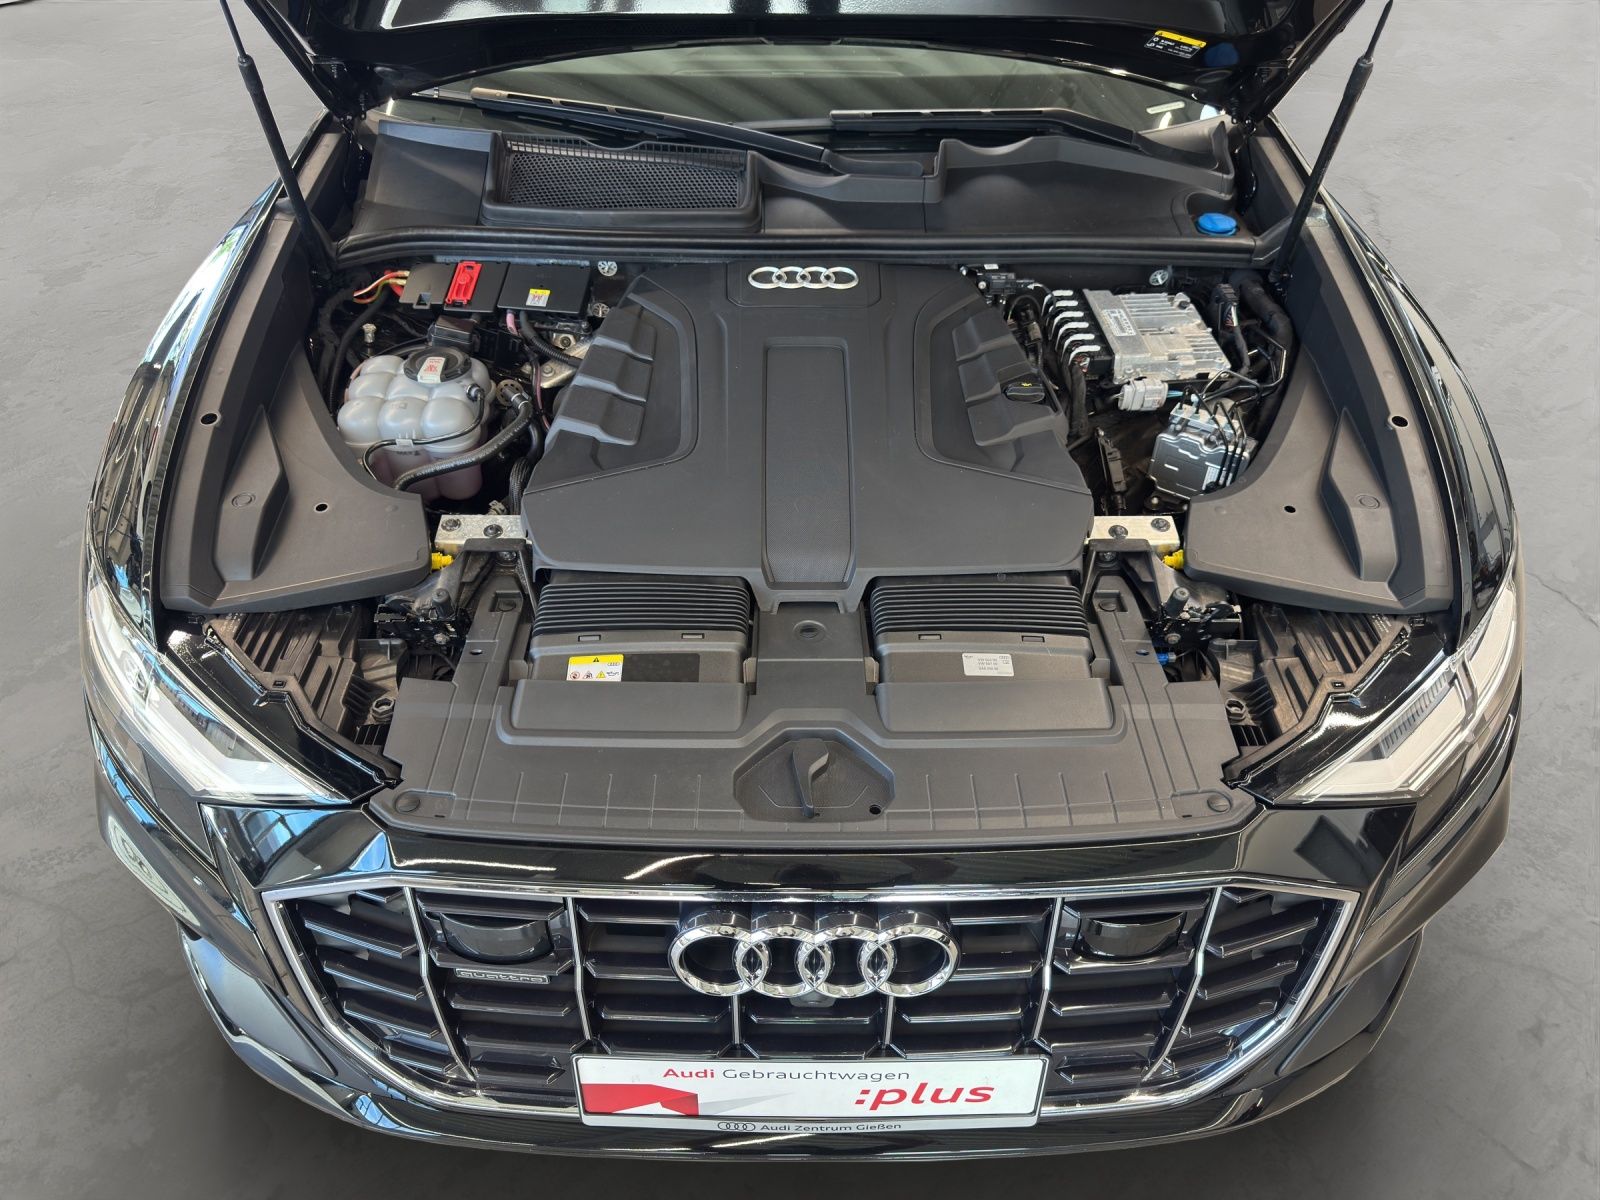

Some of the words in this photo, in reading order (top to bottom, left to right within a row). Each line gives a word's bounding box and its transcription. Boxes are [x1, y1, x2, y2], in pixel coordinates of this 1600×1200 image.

[460, 971, 542, 982] quattro
[663, 1068, 715, 1079] Audi
[722, 1069, 910, 1083] Gebrauchtwagen
[760, 1124, 791, 1132] Audi
[855, 1123, 902, 1131] Gießen
